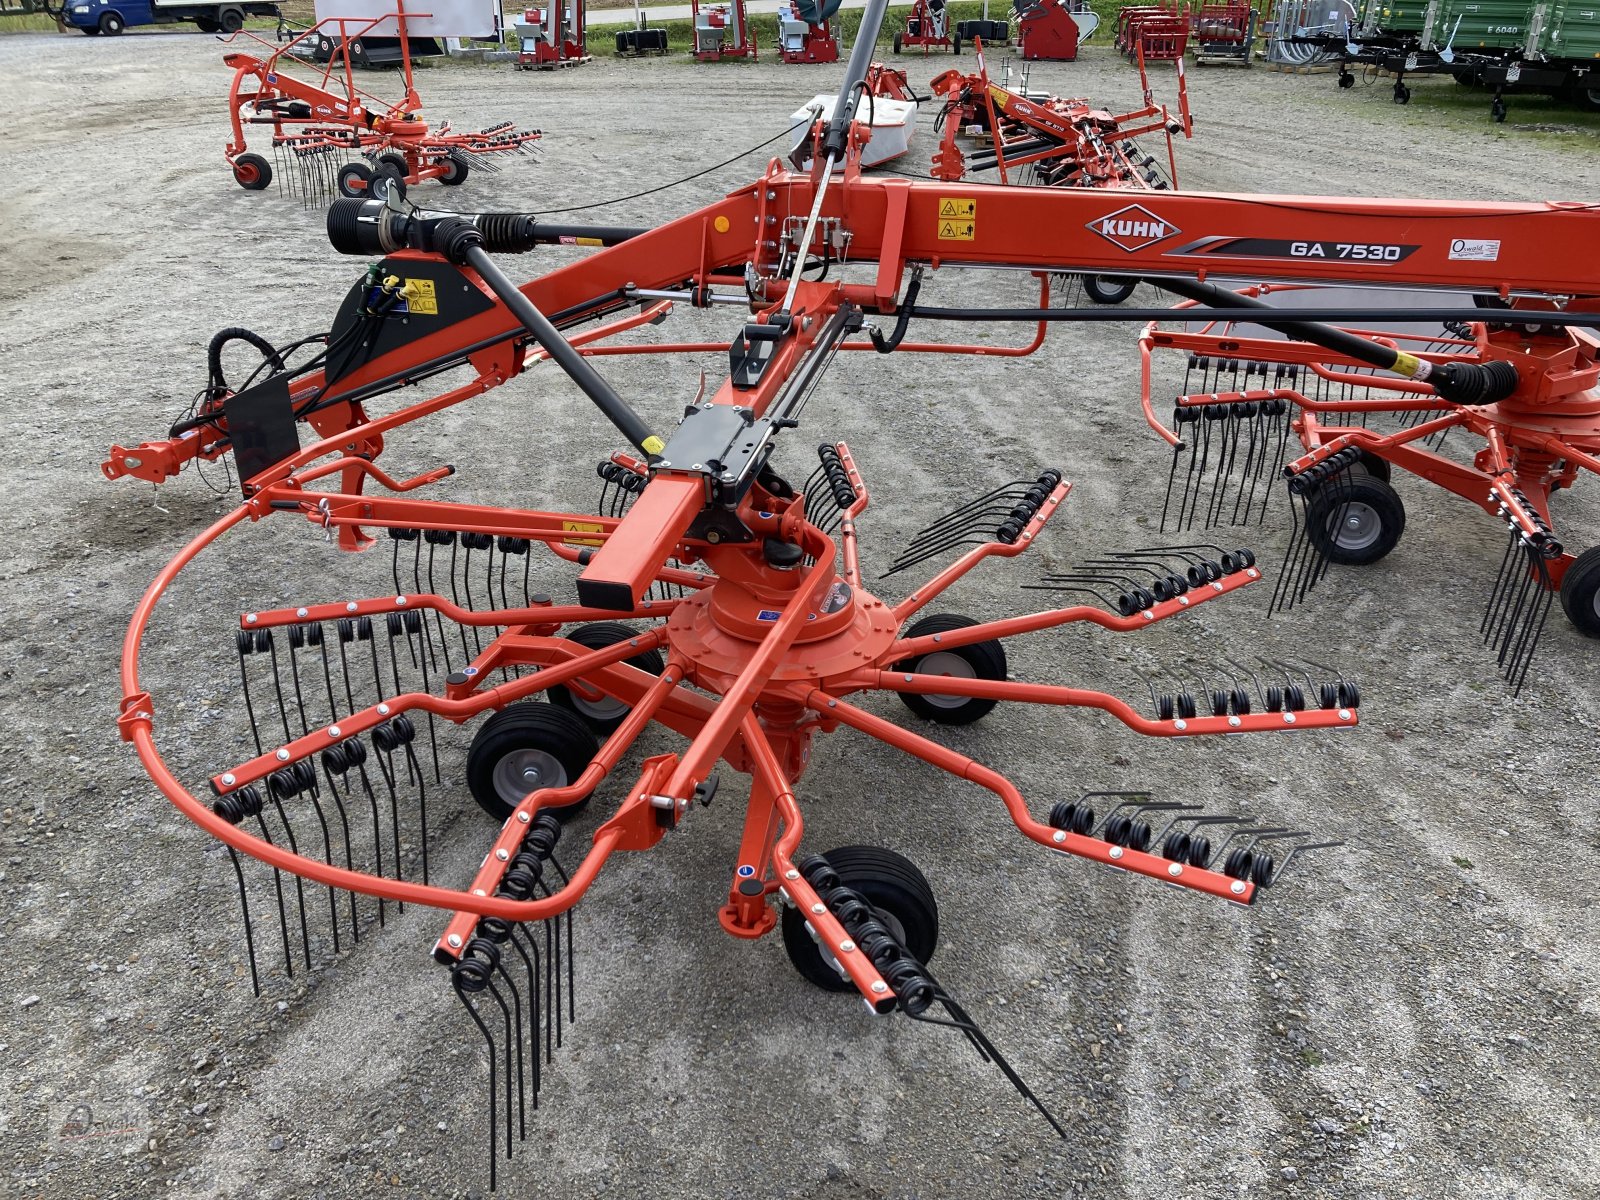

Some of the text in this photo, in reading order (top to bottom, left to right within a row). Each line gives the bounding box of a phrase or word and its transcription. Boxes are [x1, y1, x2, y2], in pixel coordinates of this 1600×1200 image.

[1495, 26, 1518, 34] 6040
[1014, 103, 1032, 115] KUHN
[1102, 219, 1165, 238] KUHN
[1290, 242, 1401, 260] GA 7530
[1452, 239, 1484, 253] Oswald
